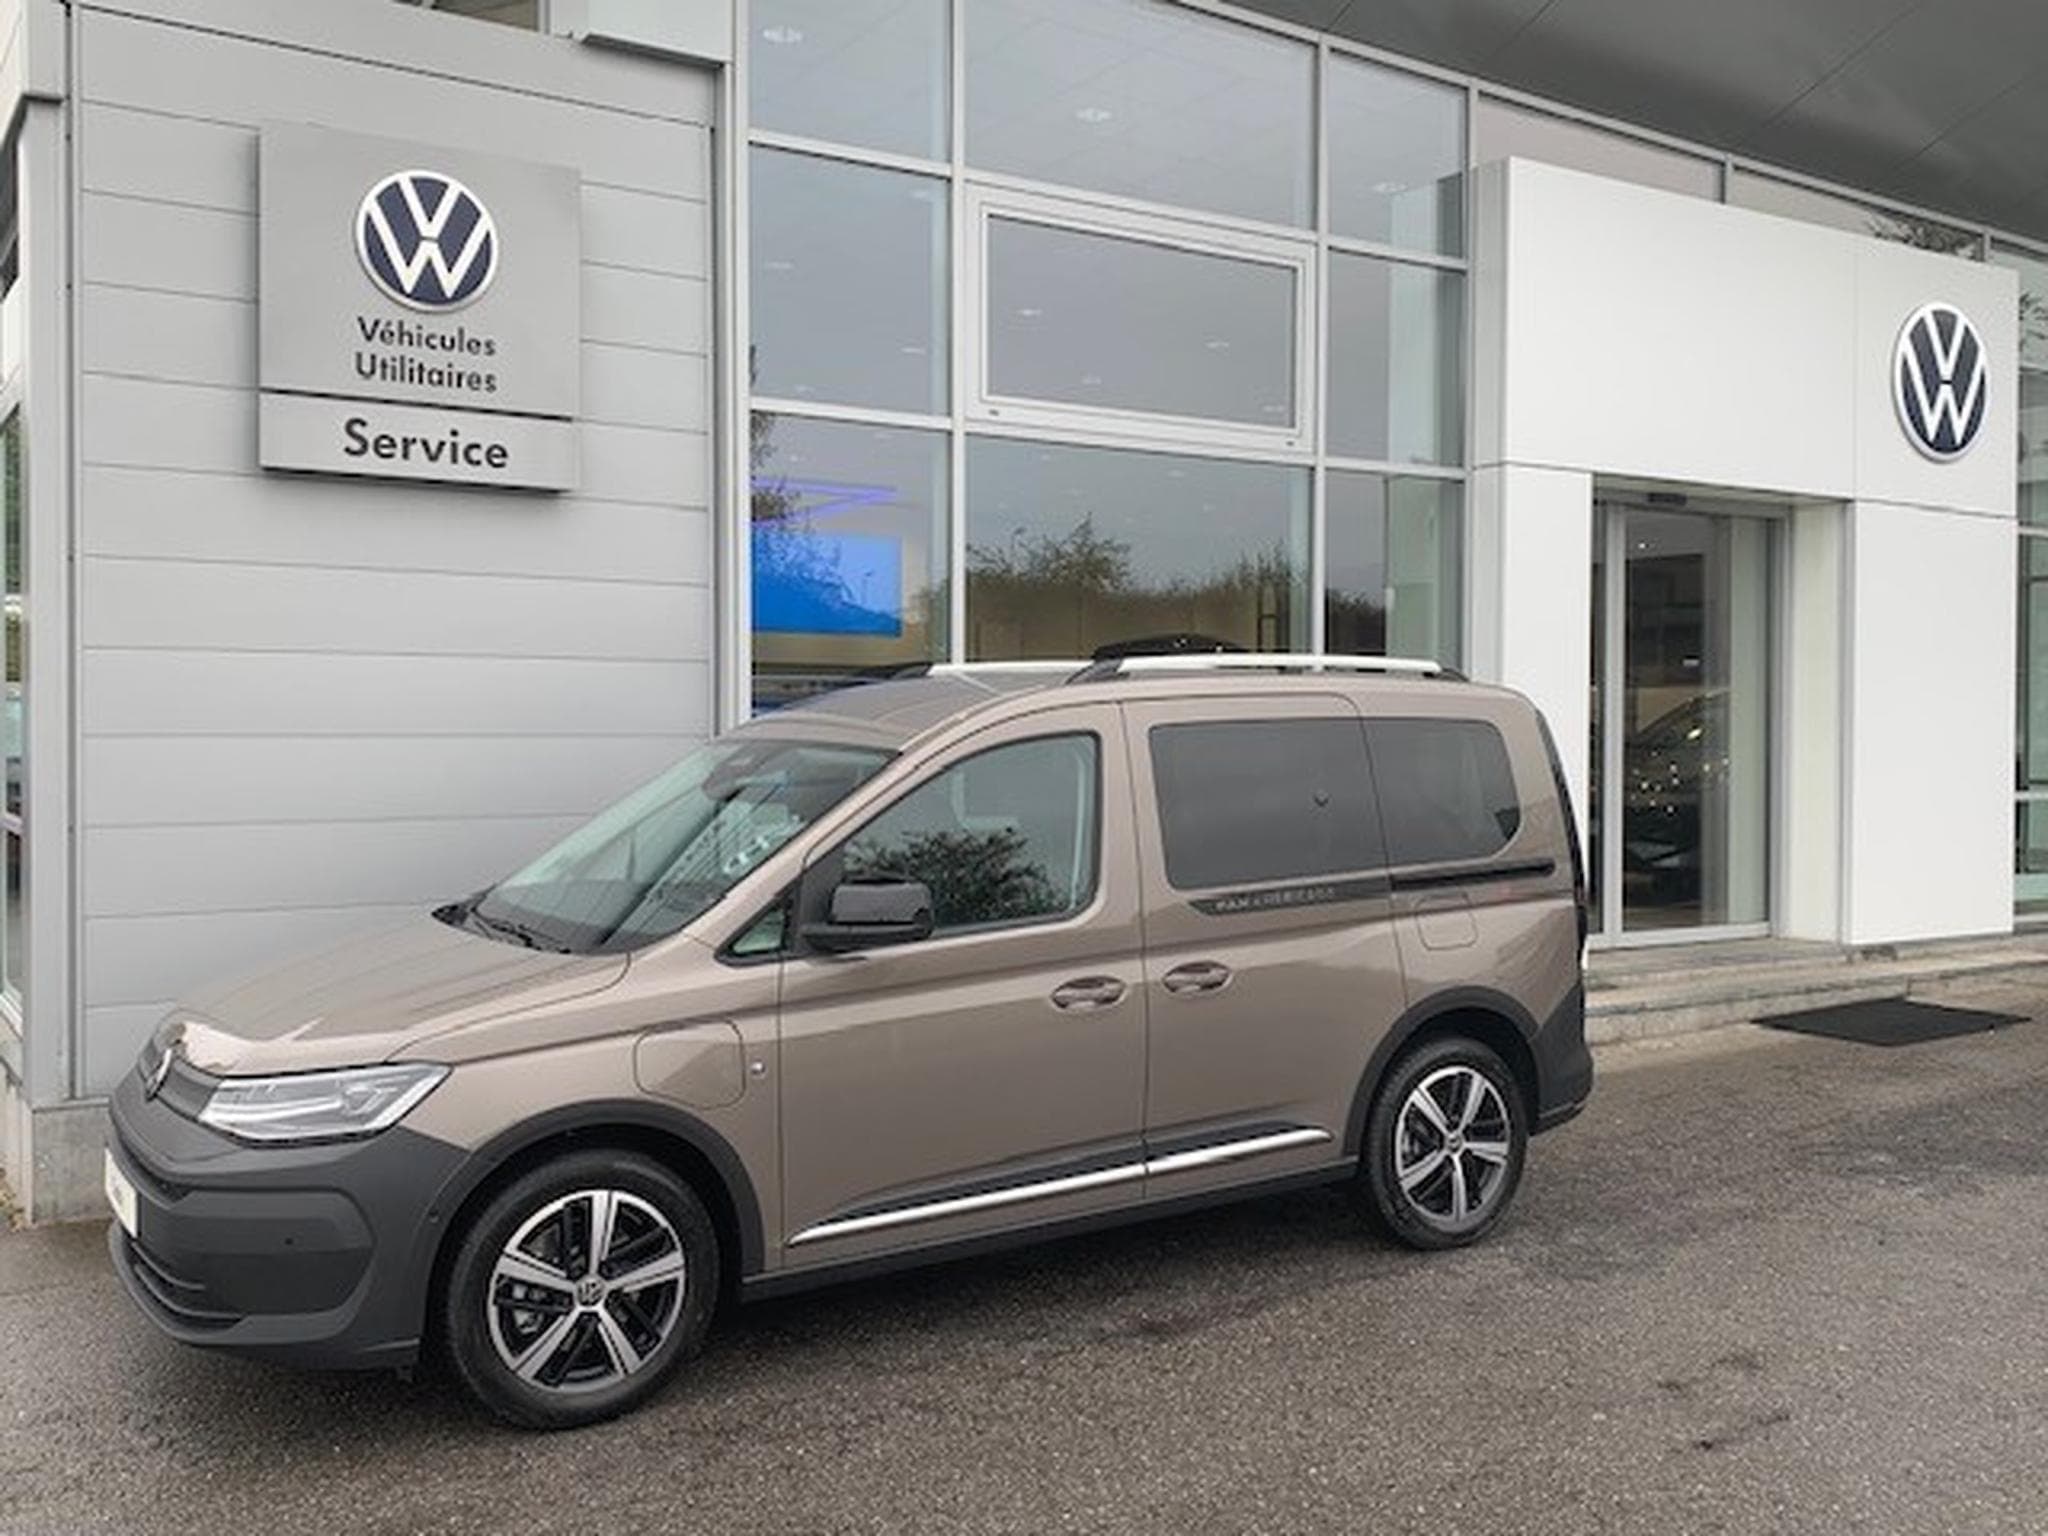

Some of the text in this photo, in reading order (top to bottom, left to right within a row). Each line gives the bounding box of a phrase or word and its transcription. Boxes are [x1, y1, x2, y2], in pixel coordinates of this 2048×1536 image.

[359, 171, 497, 306] VW
[357, 315, 496, 357] Véhicules
[355, 352, 497, 393] Utilitaires
[1898, 304, 1988, 450] VW
[343, 417, 509, 469] Service
